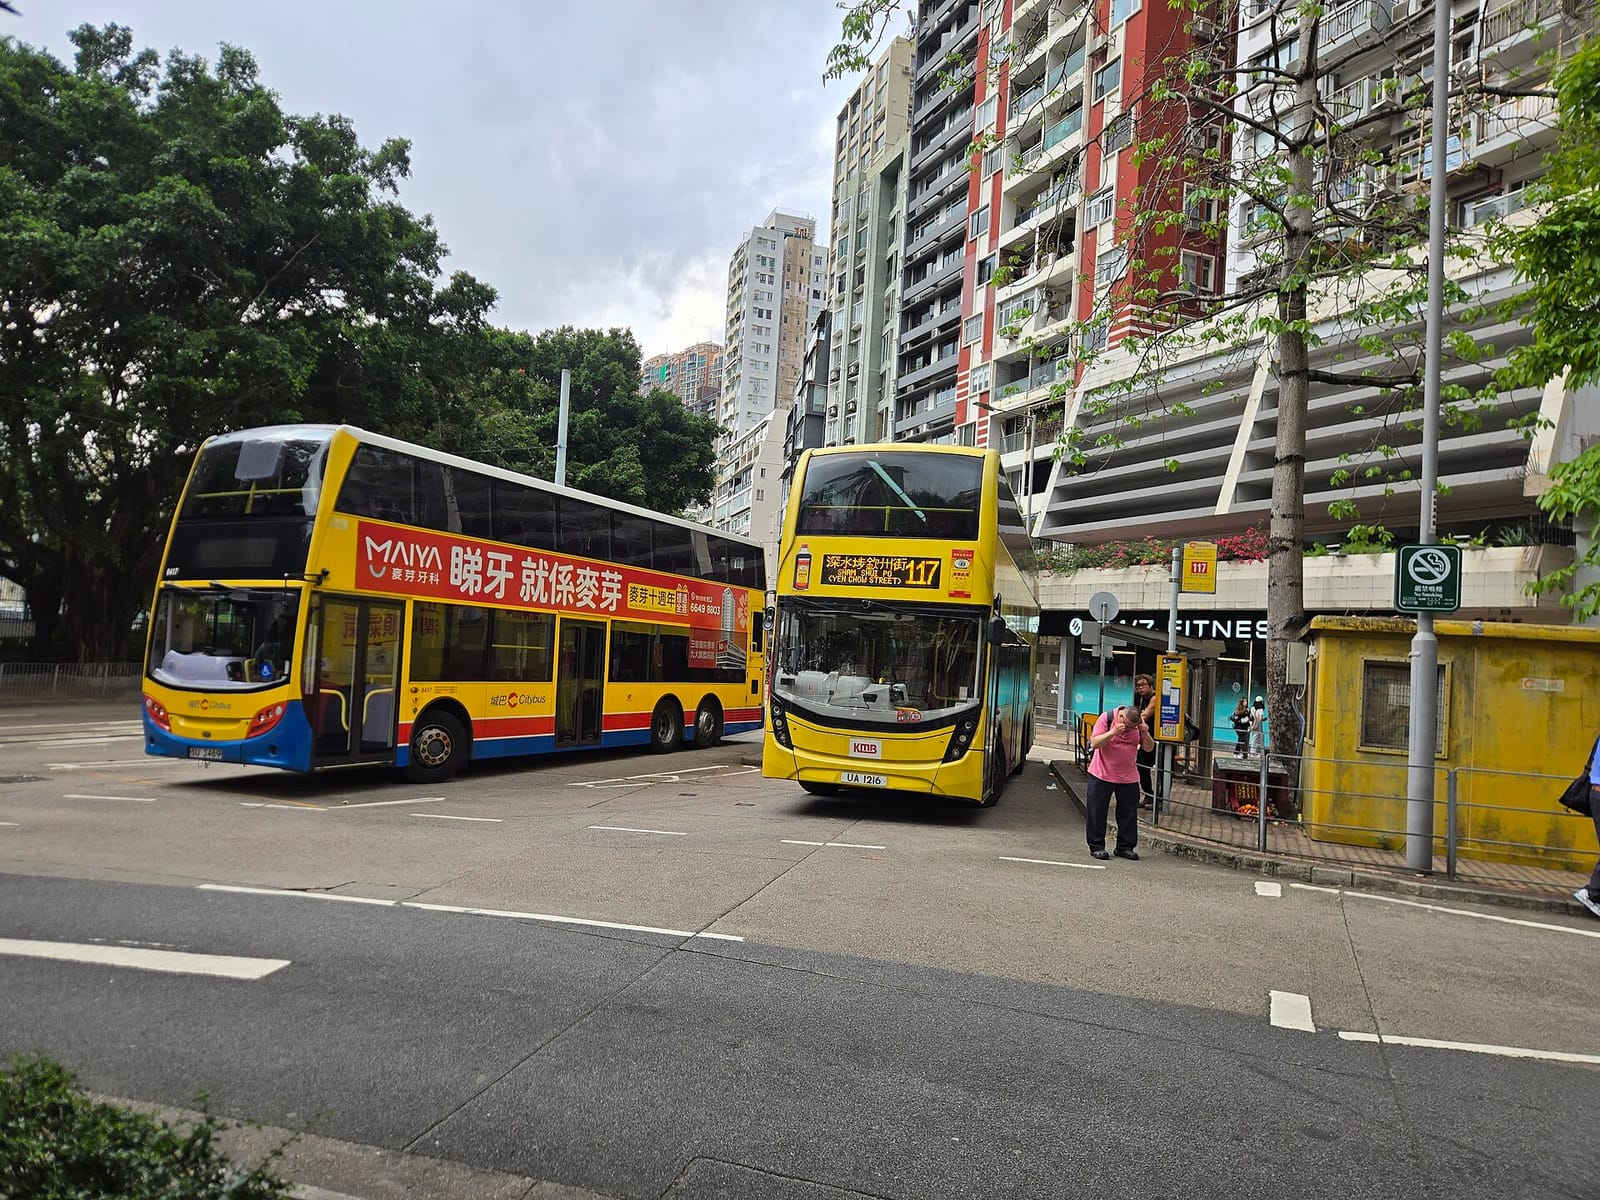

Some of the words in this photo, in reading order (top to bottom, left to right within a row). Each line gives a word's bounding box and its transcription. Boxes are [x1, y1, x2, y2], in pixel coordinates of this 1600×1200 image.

[365, 535, 443, 571] MAIYA
[826, 556, 908, 571] 深水埗欽州街
[1192, 562, 1207, 573] 117
[391, 567, 440, 585] 麥芽牙科
[450, 545, 514, 599] 睇牙
[519, 556, 623, 612] 就係麥芽
[837, 568, 857, 577] SHAM
[860, 569, 879, 578] SHUI
[882, 569, 893, 578] PO
[905, 559, 940, 585] 117
[828, 574, 847, 583] (YEN
[848, 575, 868, 584] CHOW
[868, 576, 902, 585] STREET)
[629, 586, 675, 608] 麥芽十週年
[690, 602, 705, 614] 6649
[706, 605, 721, 616] 8803
[1168, 619, 1268, 639] FITNES
[208, 701, 232, 710] Citybus
[490, 695, 507, 707] 城巴
[518, 694, 547, 705] Citybus
[853, 743, 877, 754] KMB
[847, 774, 859, 783] UA
[863, 776, 881, 785] 1216
